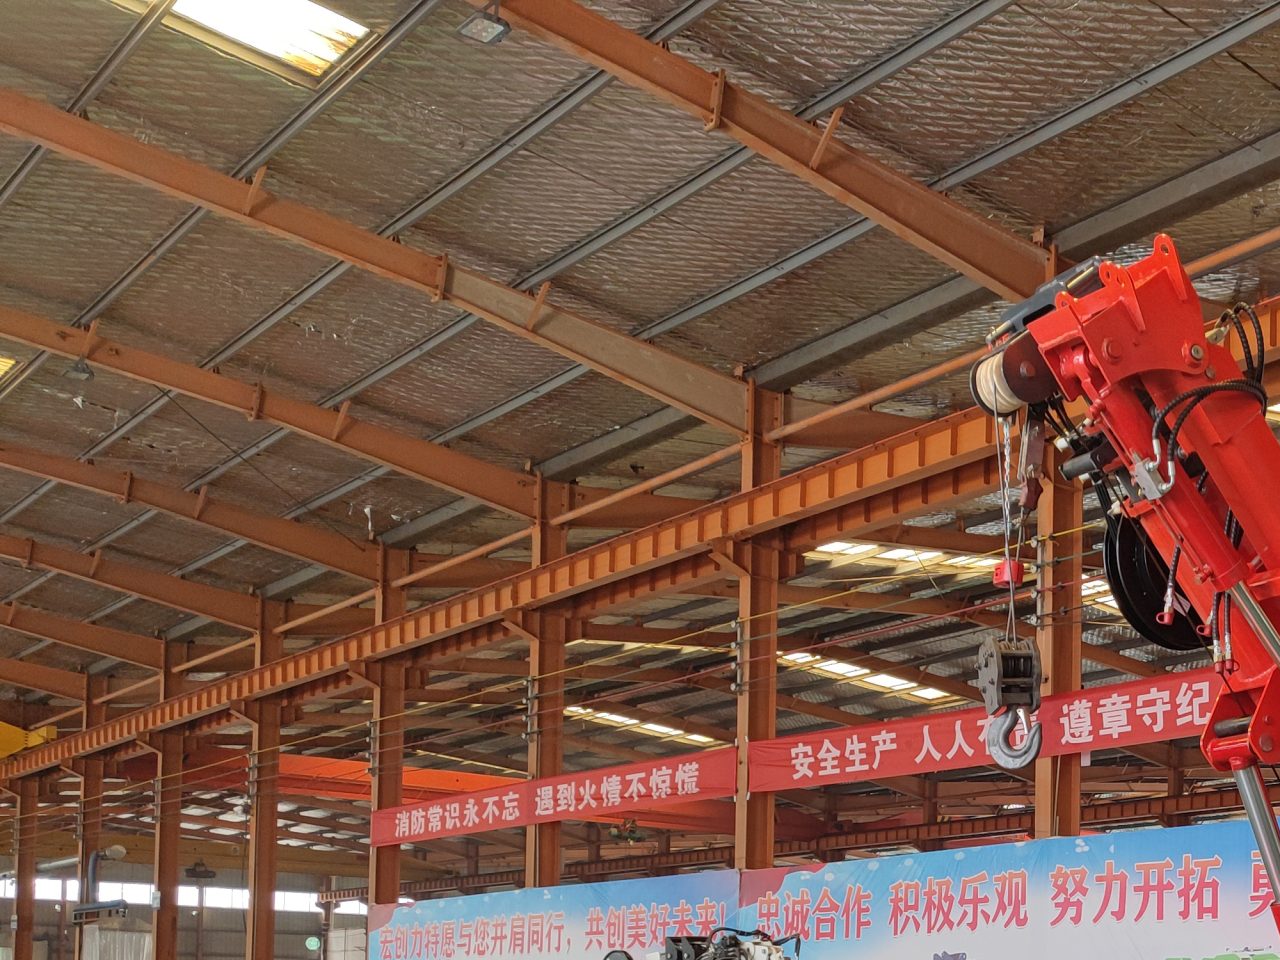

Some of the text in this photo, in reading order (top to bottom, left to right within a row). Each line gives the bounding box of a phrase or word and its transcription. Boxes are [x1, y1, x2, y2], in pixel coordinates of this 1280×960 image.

[790, 729, 897, 780] 安全生产
[1060, 681, 1211, 745] 遵章守纪
[395, 762, 700, 838] 消防常识永不忘 遇到火情不惊慌
[755, 882, 873, 942] 忠诚合作
[888, 868, 1029, 937] 积极乐观
[1048, 854, 1224, 927] 努力开拓
